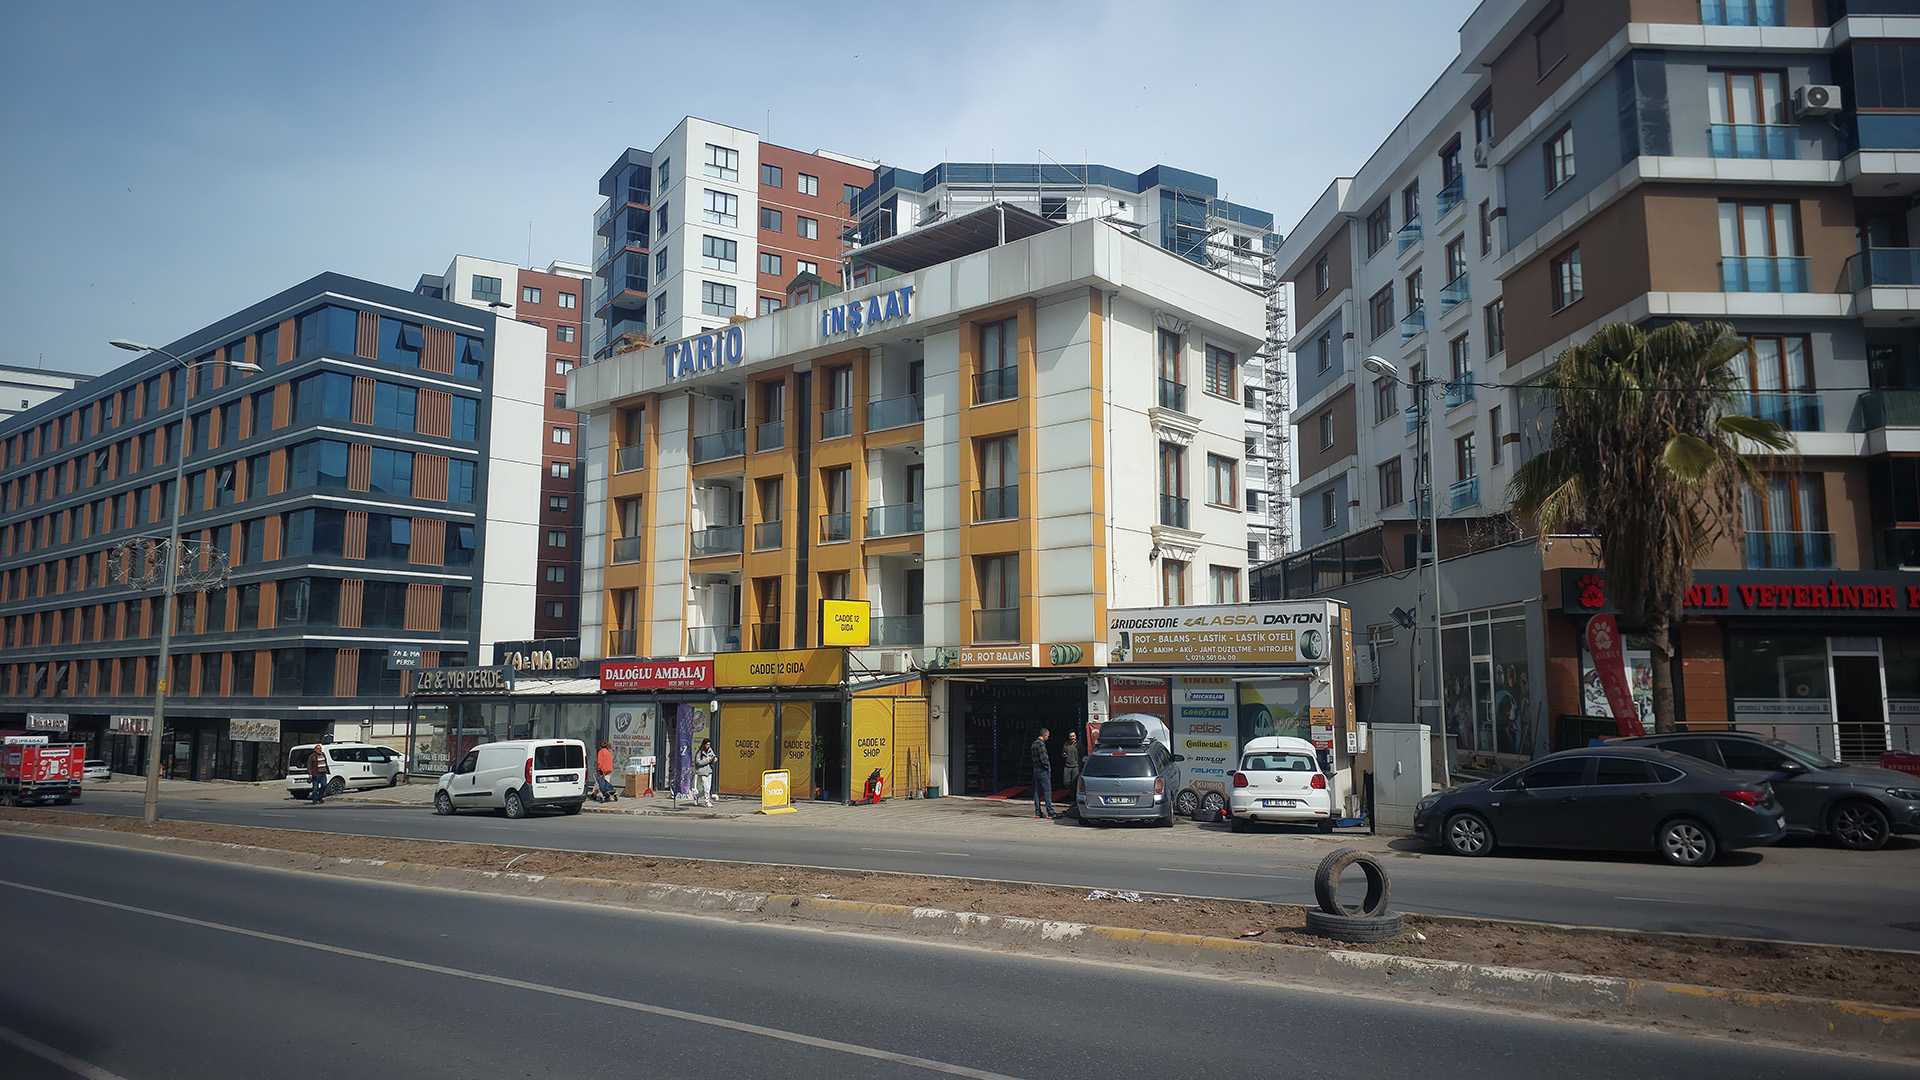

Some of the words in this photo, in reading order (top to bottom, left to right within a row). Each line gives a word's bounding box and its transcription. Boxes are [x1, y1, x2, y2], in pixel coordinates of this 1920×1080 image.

[822, 285, 915, 337] İNŞAAT
[1738, 578, 1898, 609] VETERİNER
[834, 614, 854, 623] CADDE
[854, 615, 860, 623] 12
[1111, 617, 1179, 630] BRIDGESTONE
[1201, 615, 1259, 627] LASSA
[1263, 613, 1323, 625] DAYTON
[840, 623, 855, 632] GIDA
[1134, 635, 1151, 644] ROT
[1159, 635, 1190, 643] BALANS
[1198, 632, 1227, 642] LASTİK
[1236, 631, 1265, 642] LASTİK
[1267, 630, 1293, 641] OTELİ
[1180, 645, 1193, 653] AKÜ
[1258, 644, 1294, 653] NİTROJEN
[961, 651, 975, 662] DR.
[977, 651, 995, 662] ROT
[997, 651, 1031, 662] BALANS
[605, 665, 652, 680] DALOĞLU
[654, 666, 706, 682] AMBALAJ
[750, 664, 775, 675] CADDE
[777, 663, 784, 674] 12
[786, 662, 805, 673] GIDA
[417, 671, 432, 689] ZA
[434, 670, 446, 689] &
[447, 671, 464, 689] MA
[467, 669, 505, 689] PERDE
[1113, 694, 1141, 704] LASTİK
[1142, 694, 1166, 705] OTELİ
[735, 739, 753, 748] CADDE
[753, 740, 760, 748] 12
[784, 740, 803, 749] CADDE
[804, 741, 810, 750] 12
[857, 738, 878, 748] CADDE
[879, 737, 886, 746] 12
[1186, 740, 1223, 748] Continental
[739, 750, 755, 758] SHOP
[789, 751, 805, 760] SHOP
[863, 748, 880, 758] SHOP
